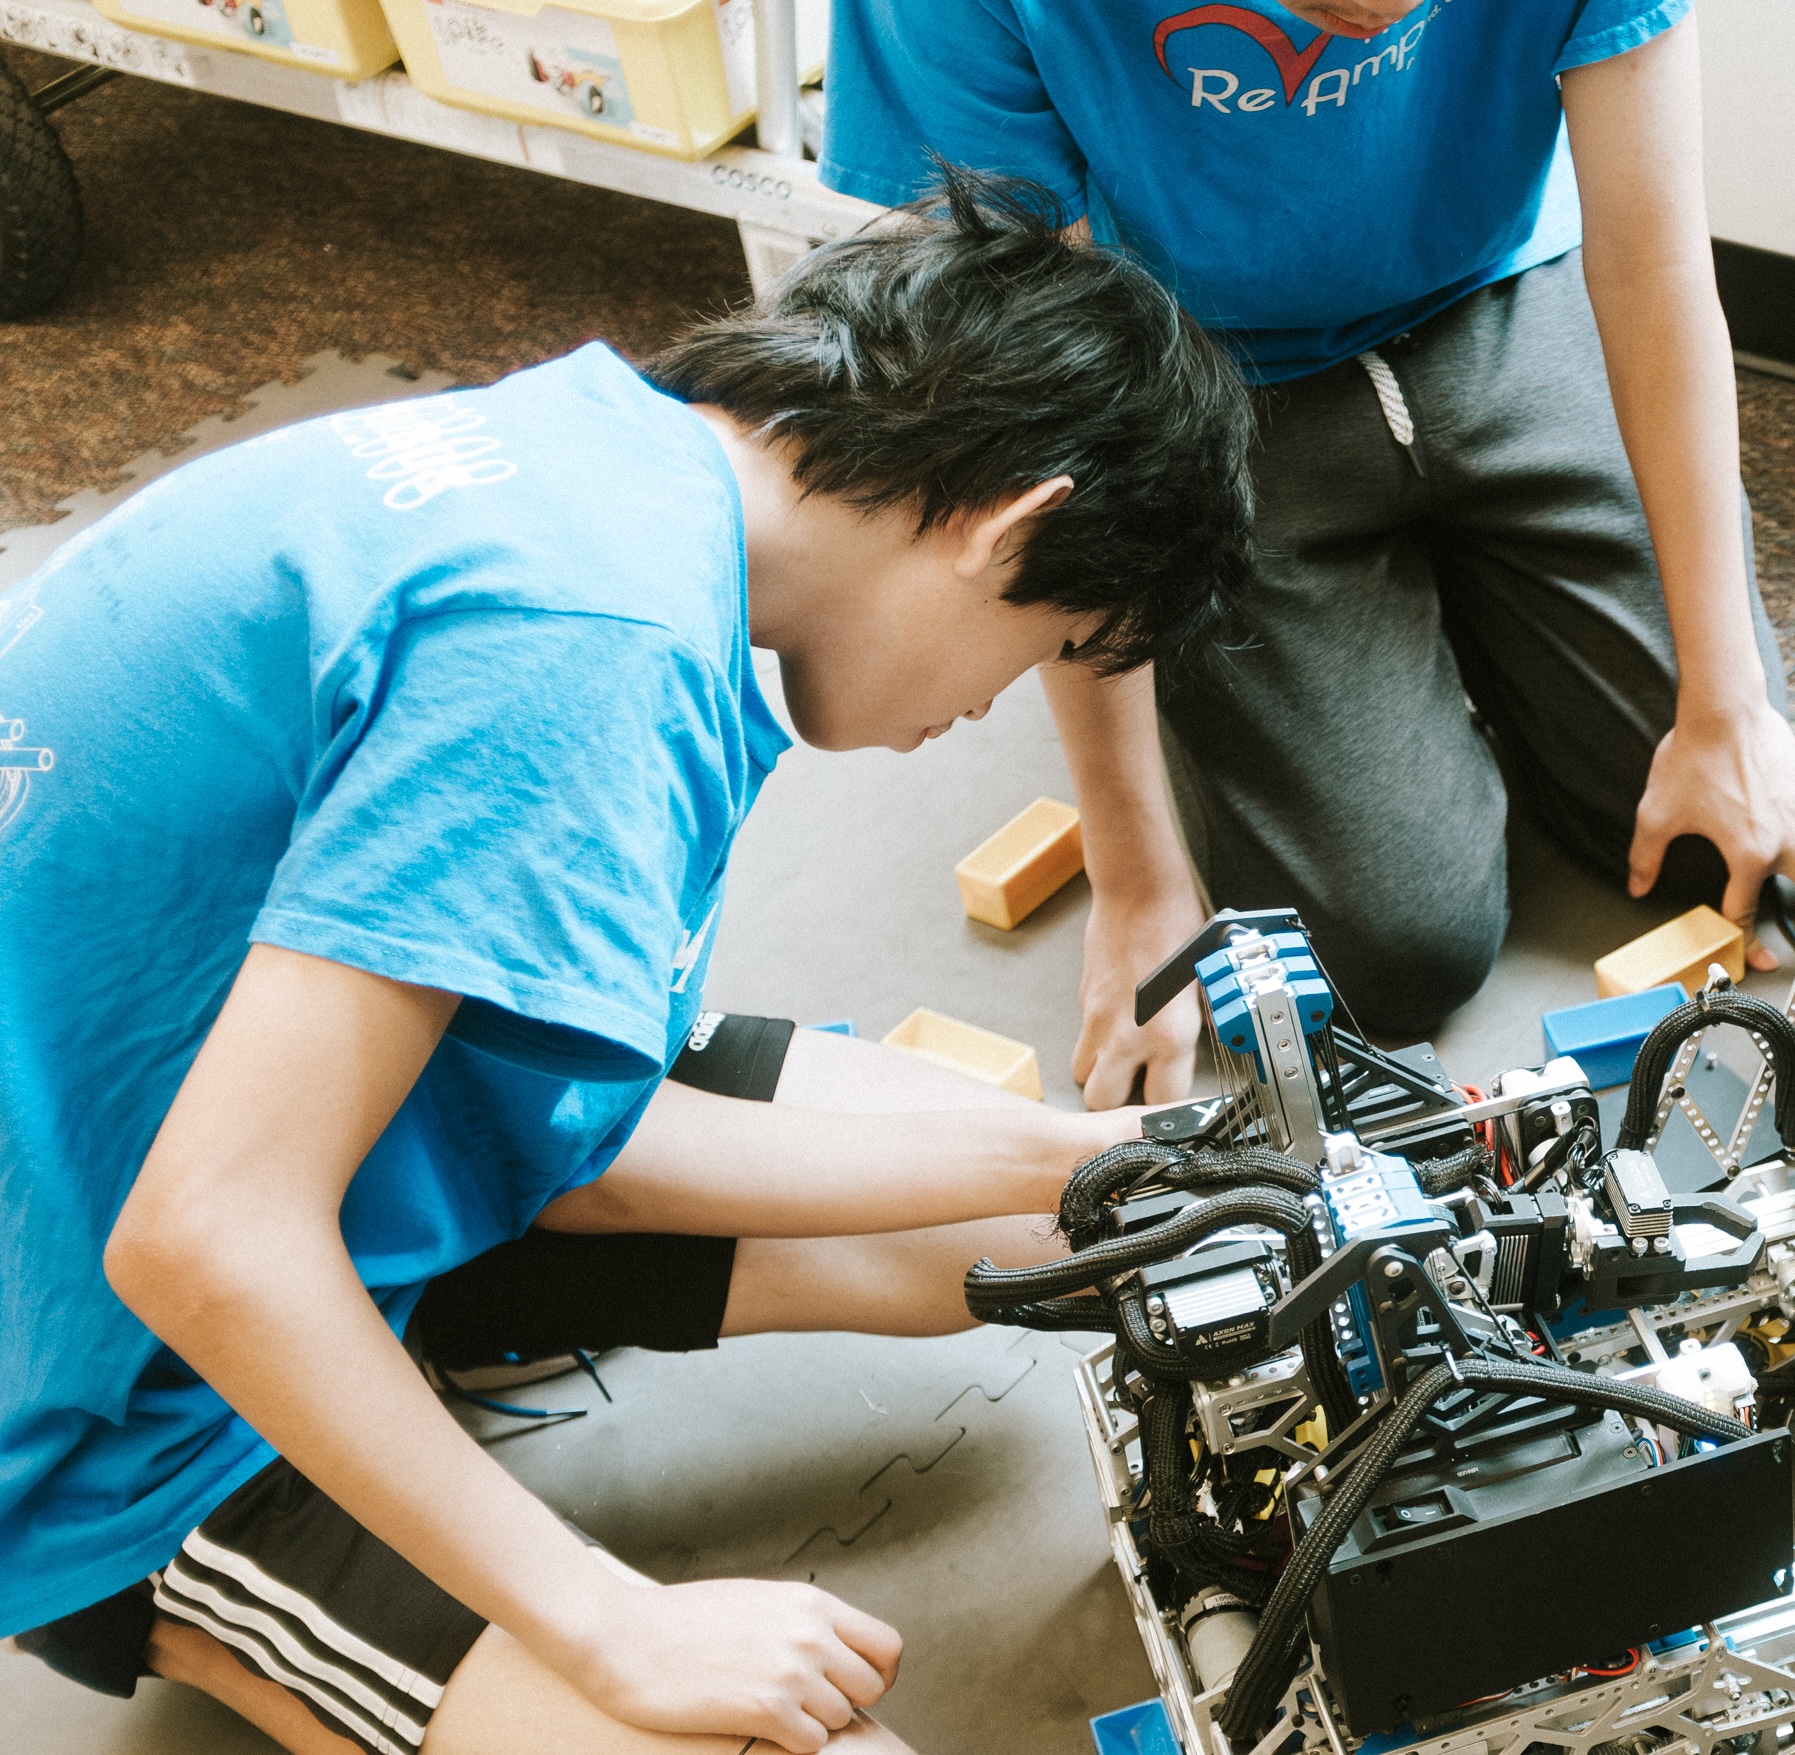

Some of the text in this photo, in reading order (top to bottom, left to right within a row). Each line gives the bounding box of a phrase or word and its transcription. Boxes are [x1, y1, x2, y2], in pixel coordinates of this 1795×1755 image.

[711, 164, 794, 201] COSCO
[1213, 1327, 1235, 1337] AXON
[1236, 1321, 1255, 1331] MAX
